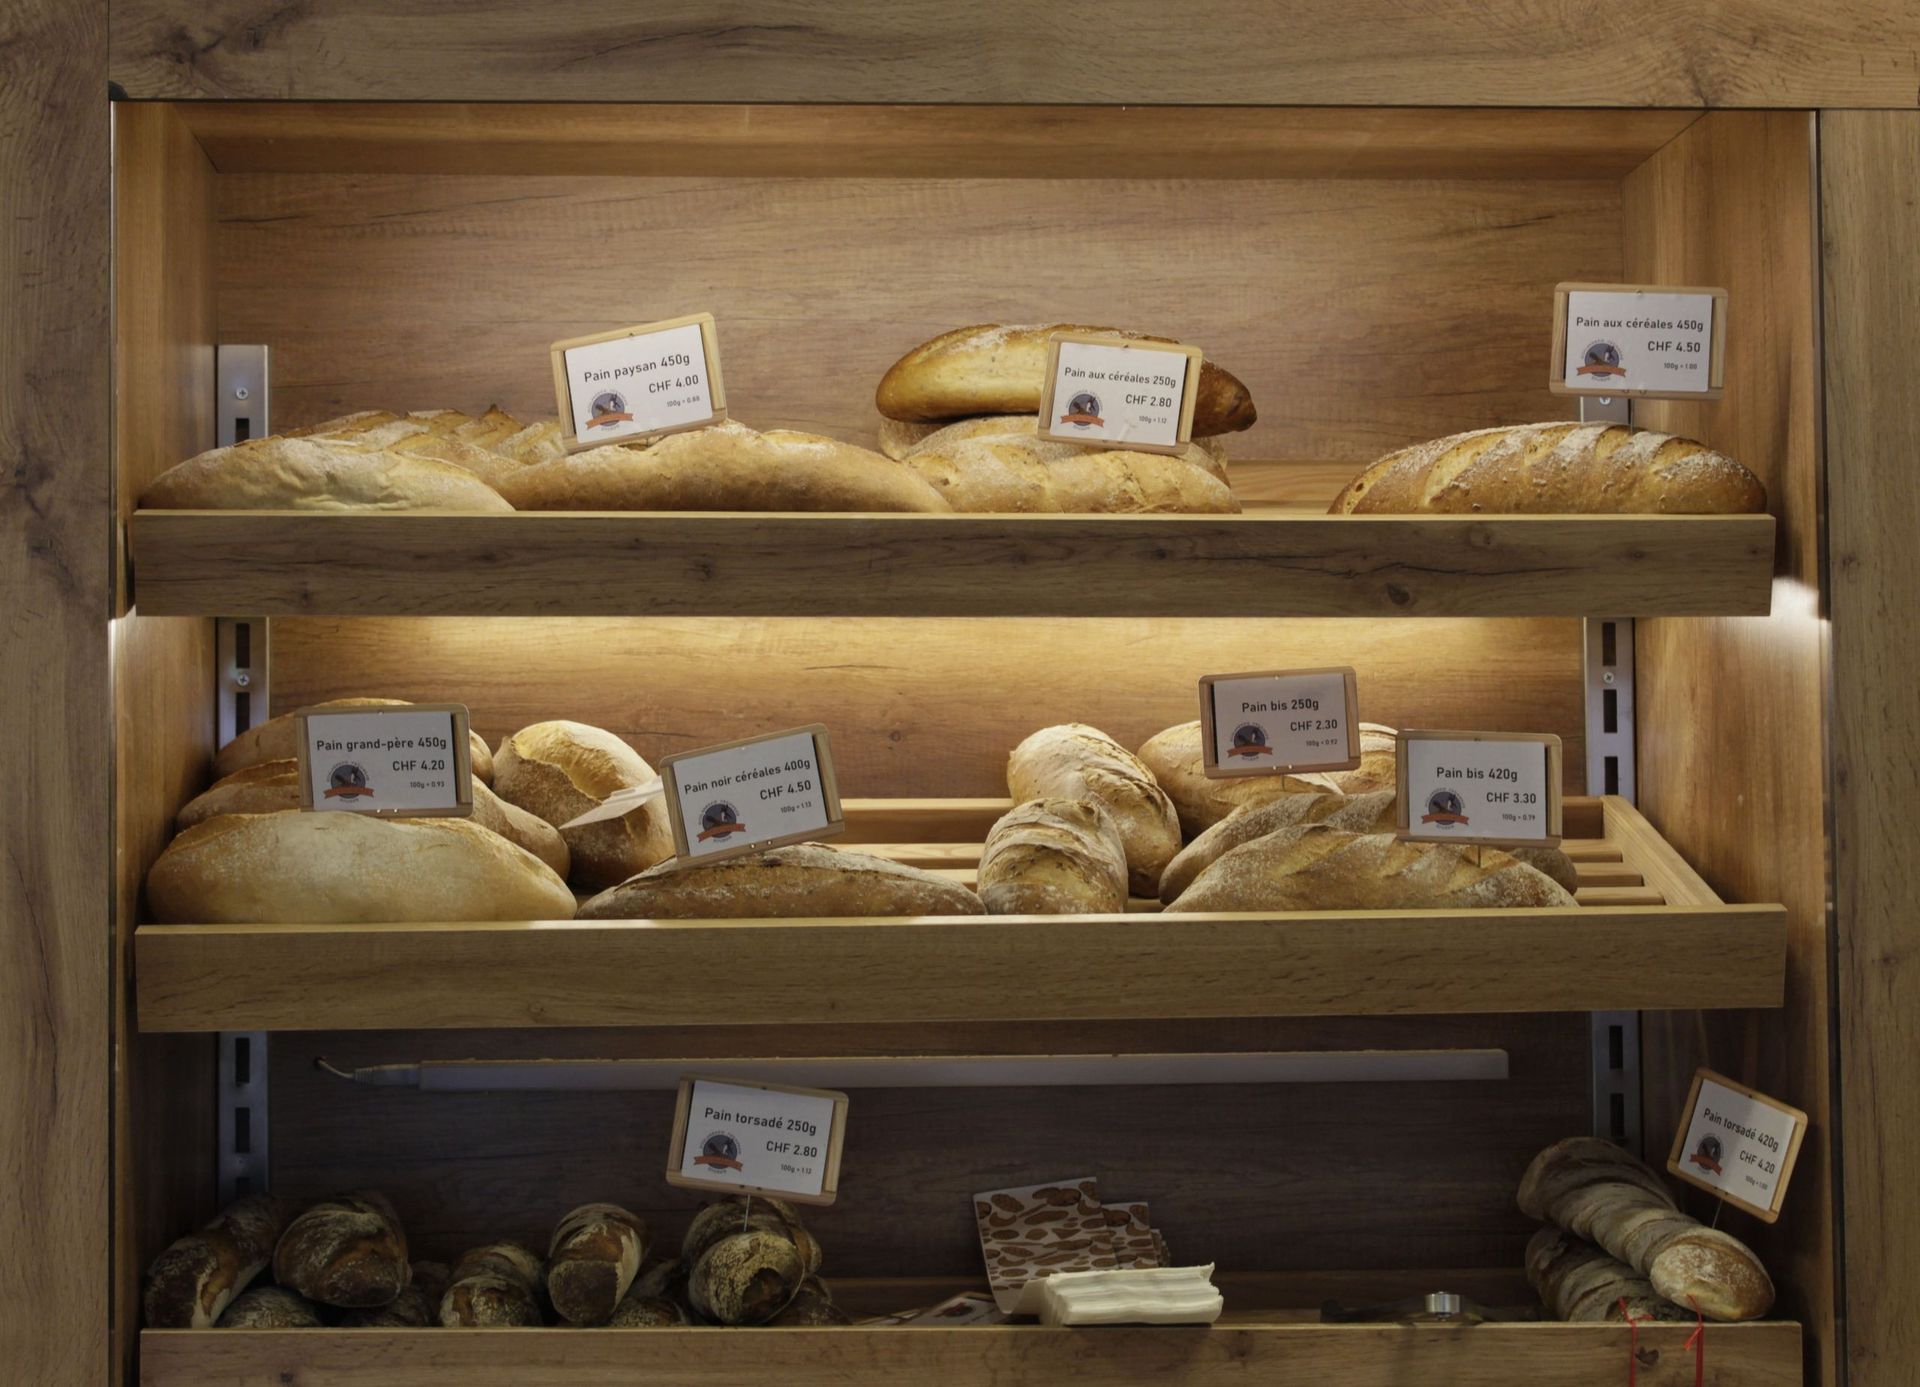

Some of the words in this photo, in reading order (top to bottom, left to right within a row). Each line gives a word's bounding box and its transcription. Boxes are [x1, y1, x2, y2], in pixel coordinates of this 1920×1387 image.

[1576, 317, 1599, 327] Pain
[1626, 318, 1673, 329] céréales
[1677, 320, 1703, 332] 450g
[1648, 341, 1672, 352] CHF
[1676, 342, 1700, 352] 4.50
[584, 369, 610, 382] Pain
[615, 362, 656, 379] paysan
[661, 354, 690, 367] 450g
[649, 380, 671, 393] CHF
[676, 375, 699, 388] 4.00
[1065, 367, 1085, 378] Pain
[1089, 371, 1105, 380] aux
[1109, 371, 1149, 384] céréales
[1153, 375, 1176, 388] 250g
[1126, 394, 1147, 406] CHF
[1150, 396, 1172, 407] 2.80
[1242, 702, 1266, 712] Pain
[1271, 700, 1287, 711] bis
[1292, 698, 1318, 711] 250g
[1290, 721, 1311, 731] CHF
[1316, 720, 1337, 730] 2.30
[316, 740, 342, 750] Pain
[347, 737, 413, 751] grand-père
[418, 737, 446, 749] 450g
[393, 761, 416, 771] CHF
[421, 760, 445, 770] 4.20
[684, 783, 708, 795] Pain
[711, 776, 732, 788] noir
[736, 766, 781, 783] céréales
[784, 759, 810, 771] 400g
[1437, 767, 1462, 778] Pain
[1467, 768, 1484, 779] bis
[1488, 768, 1518, 782] 420g
[760, 786, 783, 800] CHF
[788, 780, 811, 794] 4.50
[1486, 792, 1509, 803] CHF
[1514, 793, 1536, 804] 3.30
[781, 804, 795, 813] 100g
[705, 1108, 731, 1121] Pain
[736, 1113, 782, 1128] torsadé
[787, 1119, 816, 1136] 250g
[1704, 1108, 1722, 1125] Pain
[1724, 1118, 1756, 1140] torsadé
[1758, 1133, 1779, 1152] 420g
[766, 1141, 790, 1153] CHF
[794, 1145, 817, 1158] 2.80
[781, 1164, 795, 1173] 100g
[1740, 1150, 1757, 1164] CHF
[1758, 1159, 1774, 1174] 4.20
